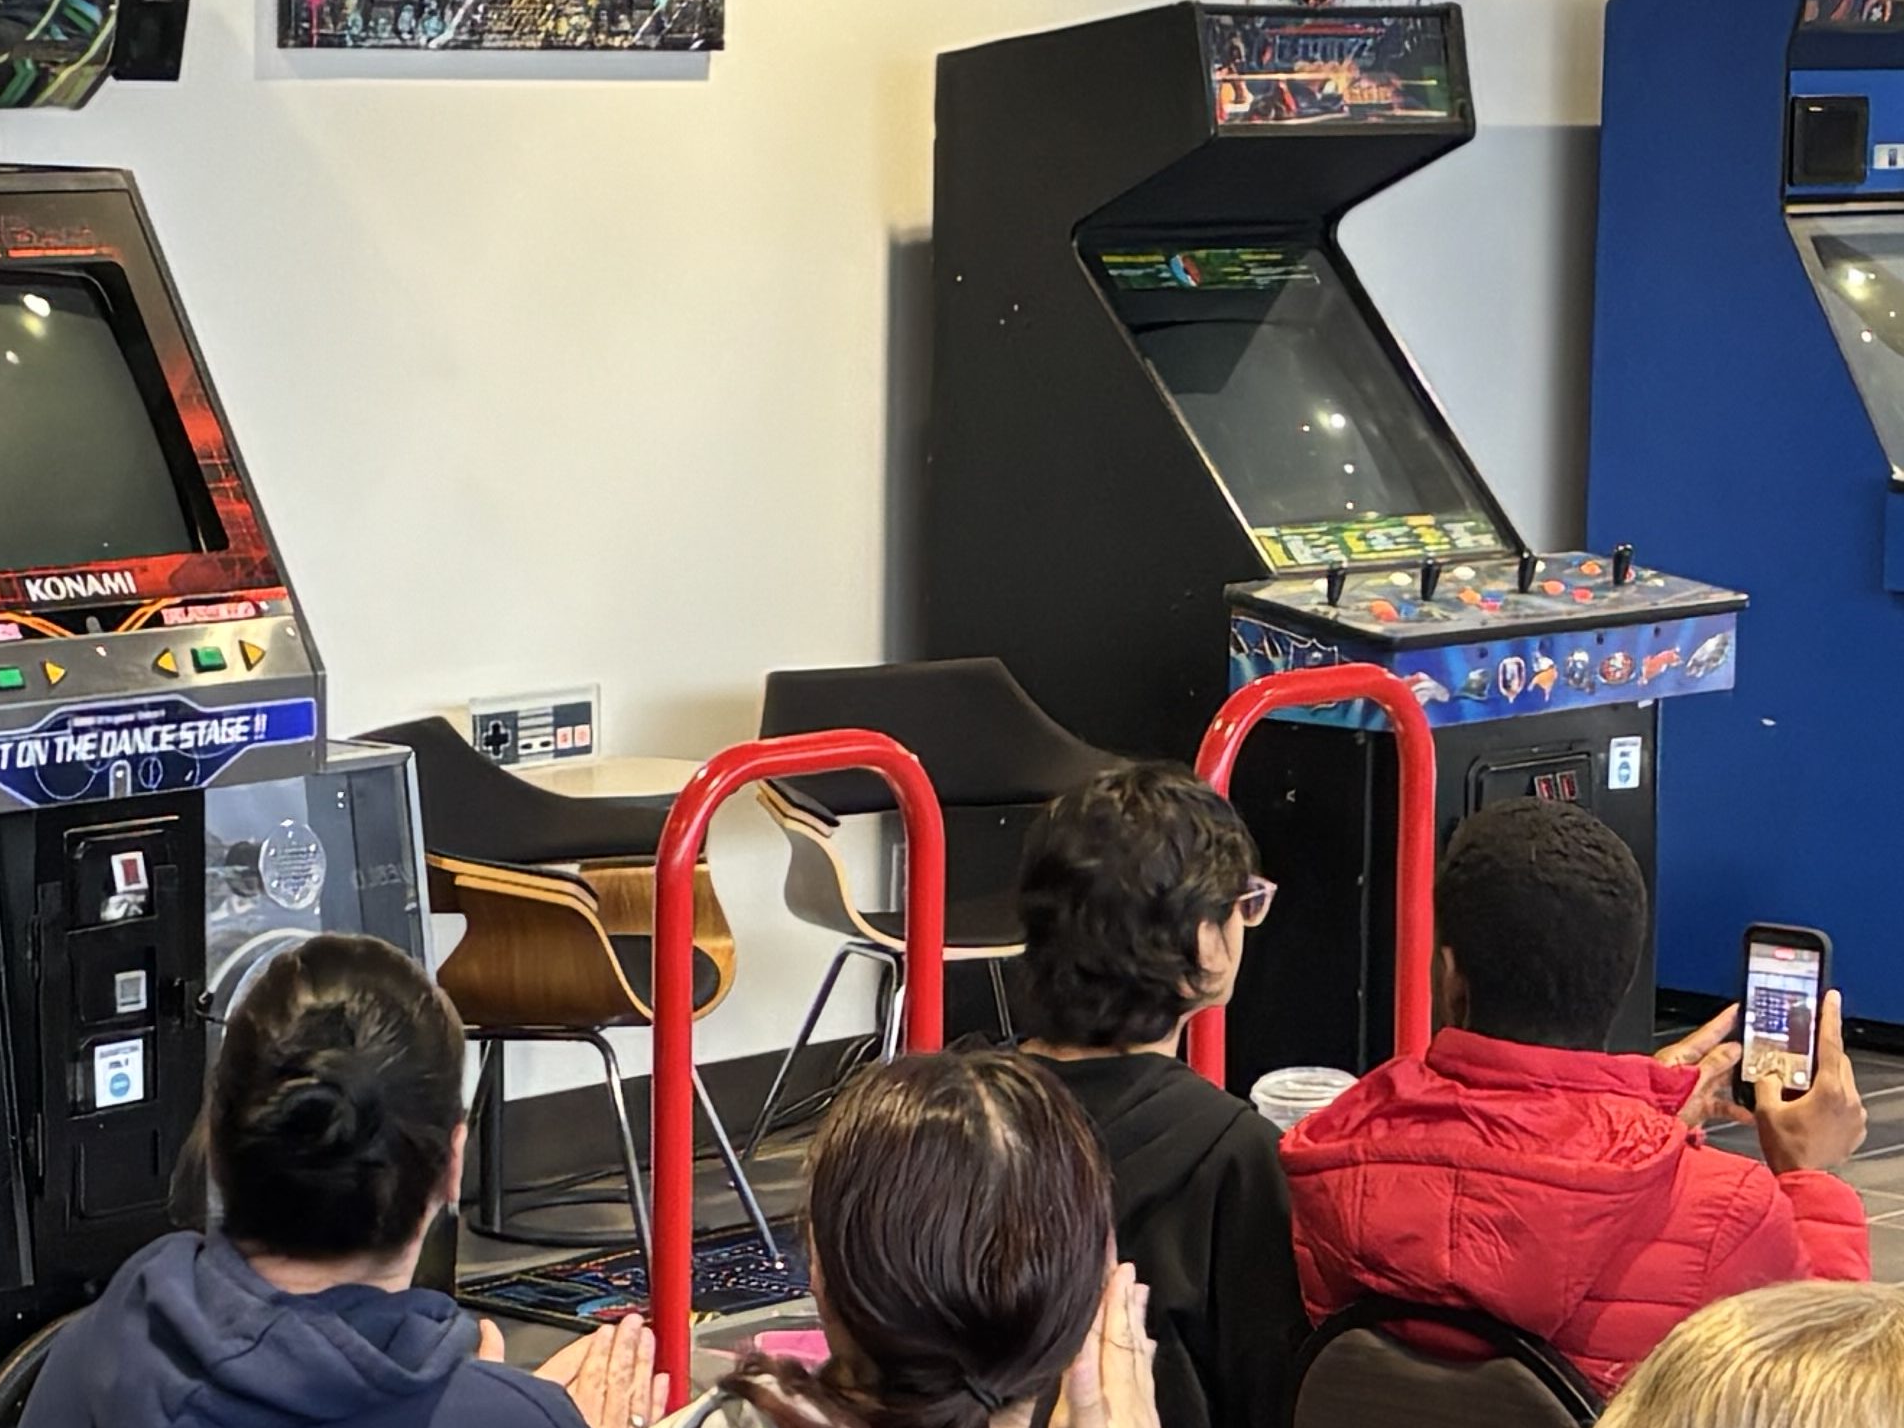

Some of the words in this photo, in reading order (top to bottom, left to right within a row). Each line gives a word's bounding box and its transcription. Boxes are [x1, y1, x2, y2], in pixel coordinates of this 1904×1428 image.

[25, 571, 137, 603] KONAMI
[16, 738, 50, 768] ON
[53, 731, 98, 764] THE
[100, 723, 177, 760] DANCE
[177, 714, 252, 750] STAGE
